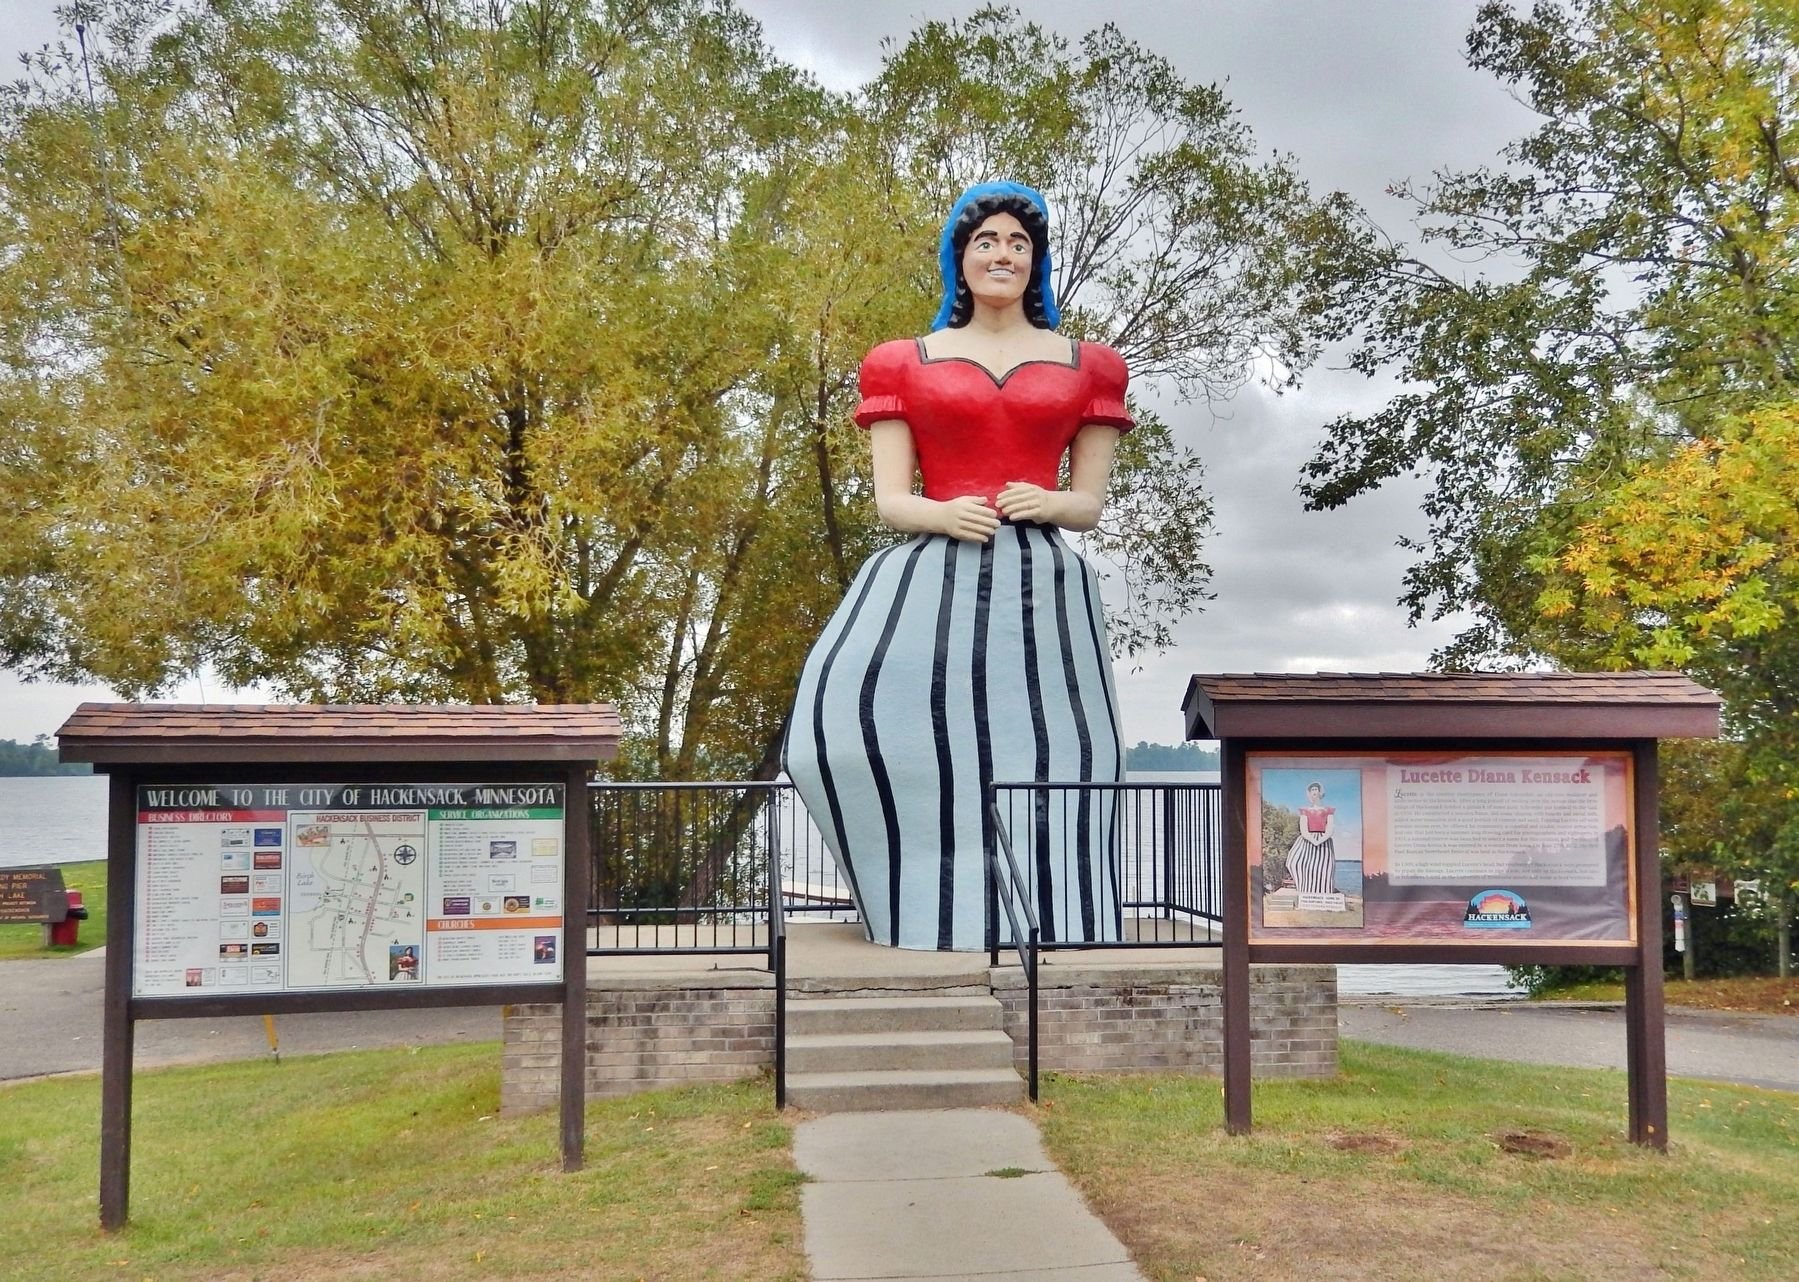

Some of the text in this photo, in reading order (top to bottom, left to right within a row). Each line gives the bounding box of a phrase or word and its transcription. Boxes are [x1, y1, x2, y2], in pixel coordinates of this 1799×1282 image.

[1400, 769, 1591, 784] Lucette Diana Kensack
[147, 789, 221, 807] WELCOME
[232, 789, 253, 806] TO
[263, 788, 289, 806] THE
[300, 788, 334, 806] CITY
[342, 788, 361, 805] OF
[475, 788, 555, 805] MINNESOTA
[148, 812, 233, 822] BUSINESS DIRECTORY
[316, 814, 421, 823] HACKENSACK BUSINESS DISTRICT
[440, 809, 530, 819] SERVICE ORGANIZATIONS
[13, 873, 47, 881] MEMORIAL
[1468, 913, 1527, 921] HACKENSACK
[438, 920, 476, 929] CHURCHES
